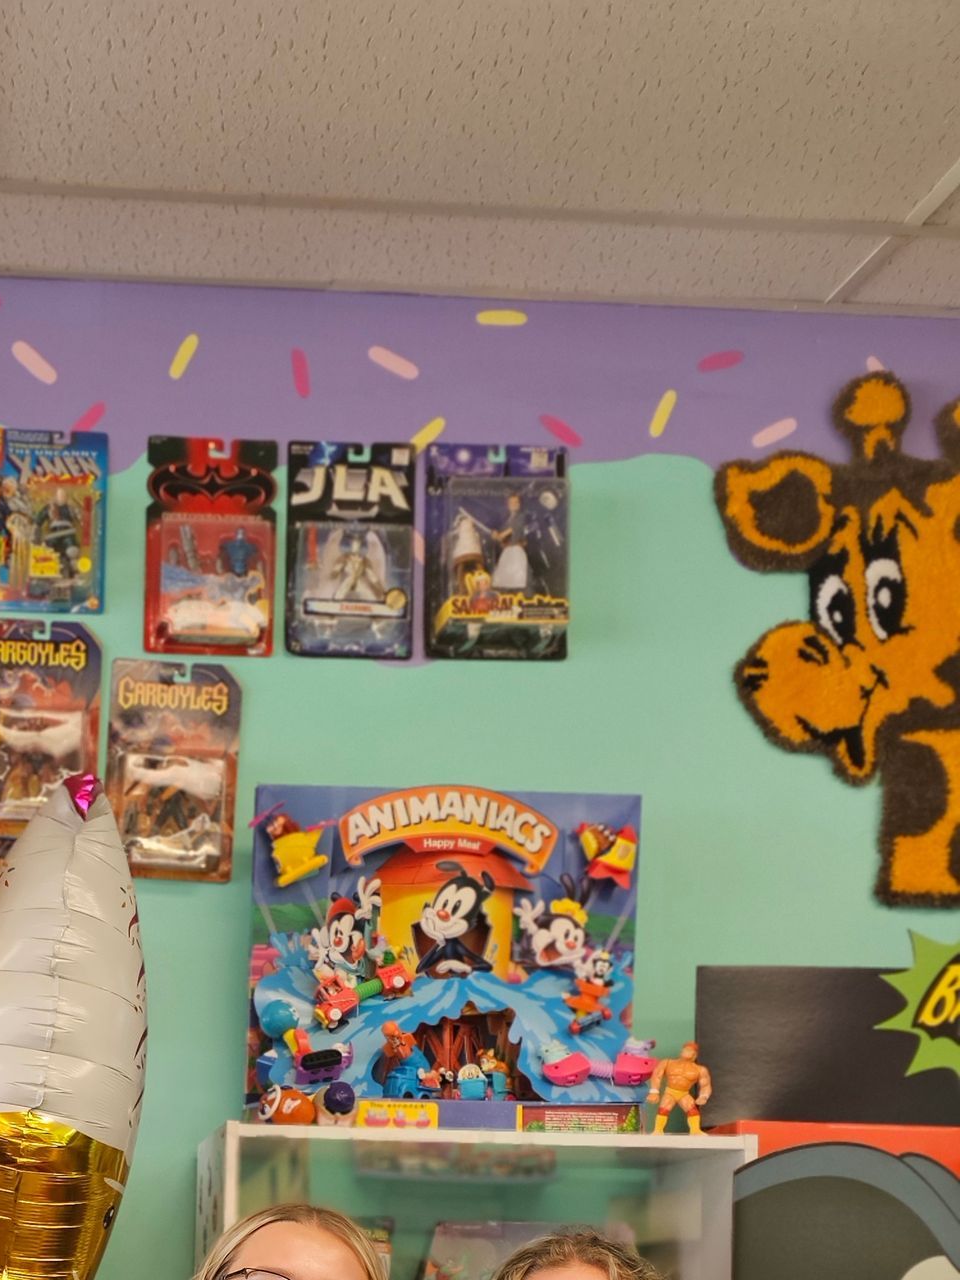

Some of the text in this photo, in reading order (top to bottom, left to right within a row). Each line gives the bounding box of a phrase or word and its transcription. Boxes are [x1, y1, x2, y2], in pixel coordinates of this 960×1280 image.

[291, 463, 411, 512] JLA
[118, 675, 229, 715] GARGOYLES
[348, 790, 551, 853] ANIMANIACS
[423, 838, 481, 850] Happy Meal
